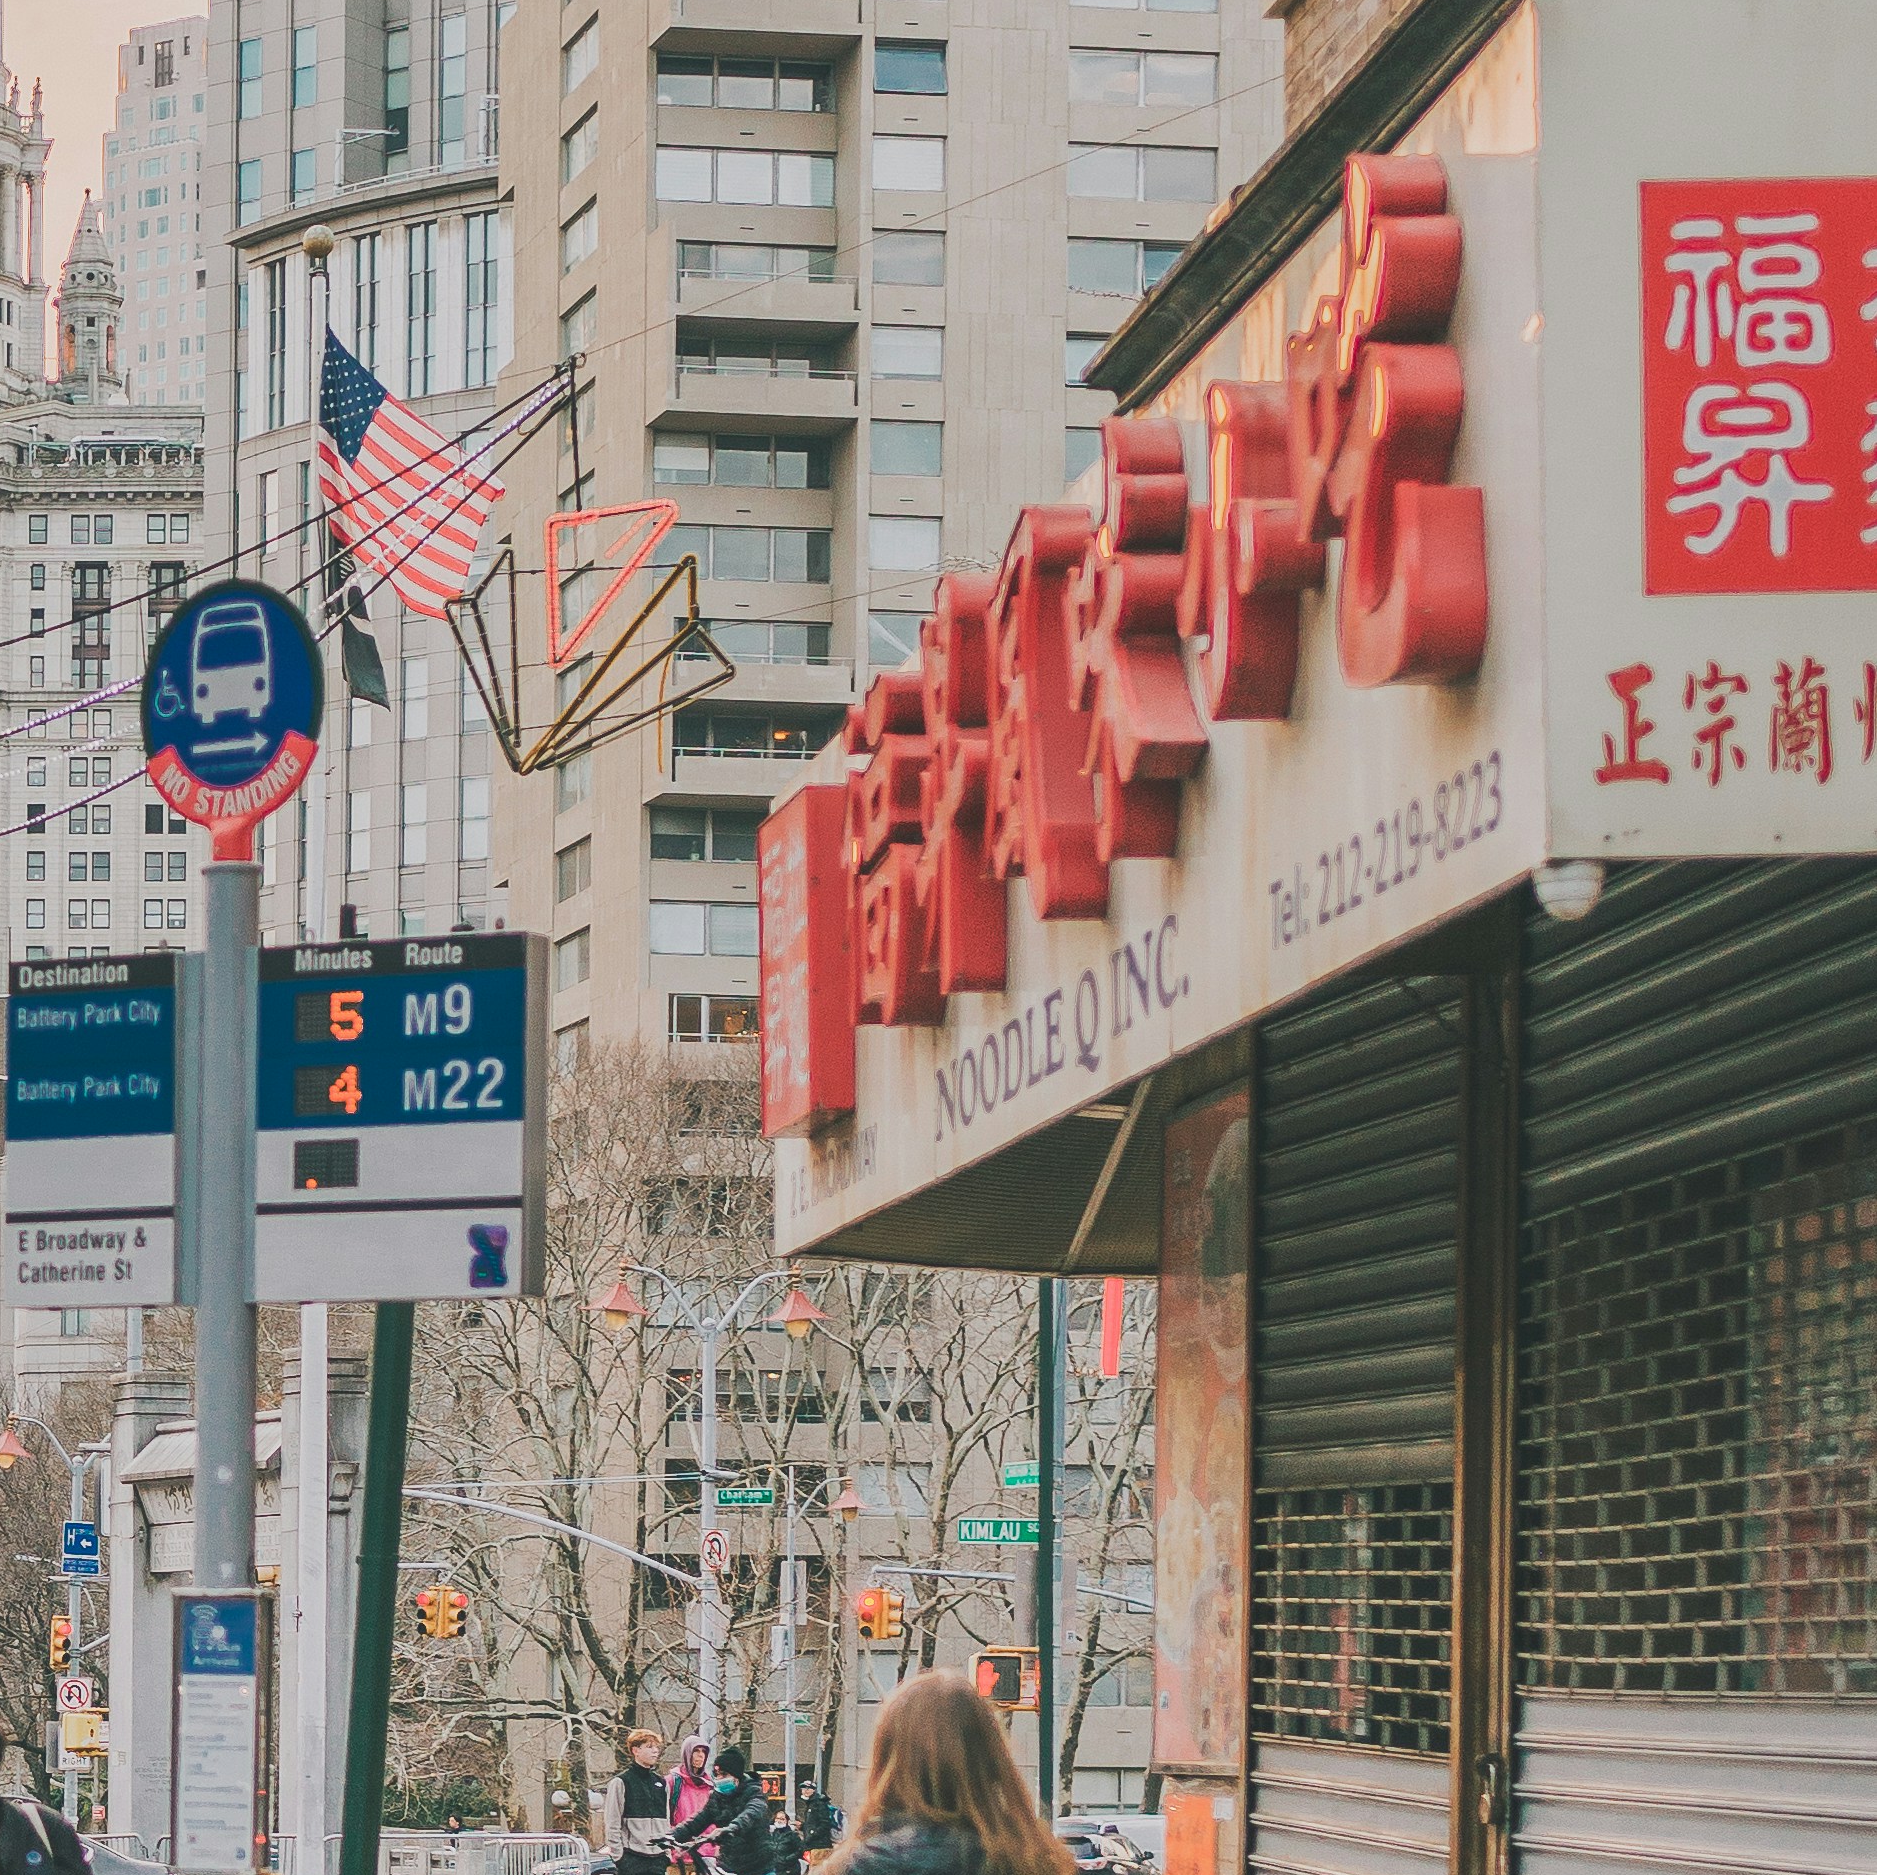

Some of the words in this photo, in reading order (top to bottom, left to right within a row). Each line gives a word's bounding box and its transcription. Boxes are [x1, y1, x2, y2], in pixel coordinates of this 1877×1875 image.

[160, 763, 191, 804] NO
[194, 750, 301, 817] STANDING
[1318, 748, 1502, 926] 212-219-8223
[295, 947, 373, 971] Minutes
[405, 942, 463, 966] Route
[19, 961, 128, 988] Destination
[18, 1007, 76, 1030] Battery
[84, 1002, 122, 1024] Park
[128, 1001, 161, 1026] City
[330, 990, 363, 1041] 5
[405, 984, 471, 1035] M9
[935, 987, 1066, 1142] NOODLE
[1075, 967, 1100, 1073] Q
[1110, 913, 1190, 1039] INC.
[18, 1079, 76, 1104] Battery
[84, 1076, 121, 1097] Park
[128, 1074, 161, 1099] City
[329, 1065, 362, 1113] 4
[404, 1058, 504, 1111] M22
[19, 1229, 28, 1251] E
[36, 1228, 126, 1253] Broadway
[134, 1227, 146, 1247] &
[18, 1261, 106, 1283] Catherine
[114, 1258, 132, 1281] St
[960, 1521, 1020, 1541] KIMLAU
[62, 1757, 87, 1765] RIGHT
